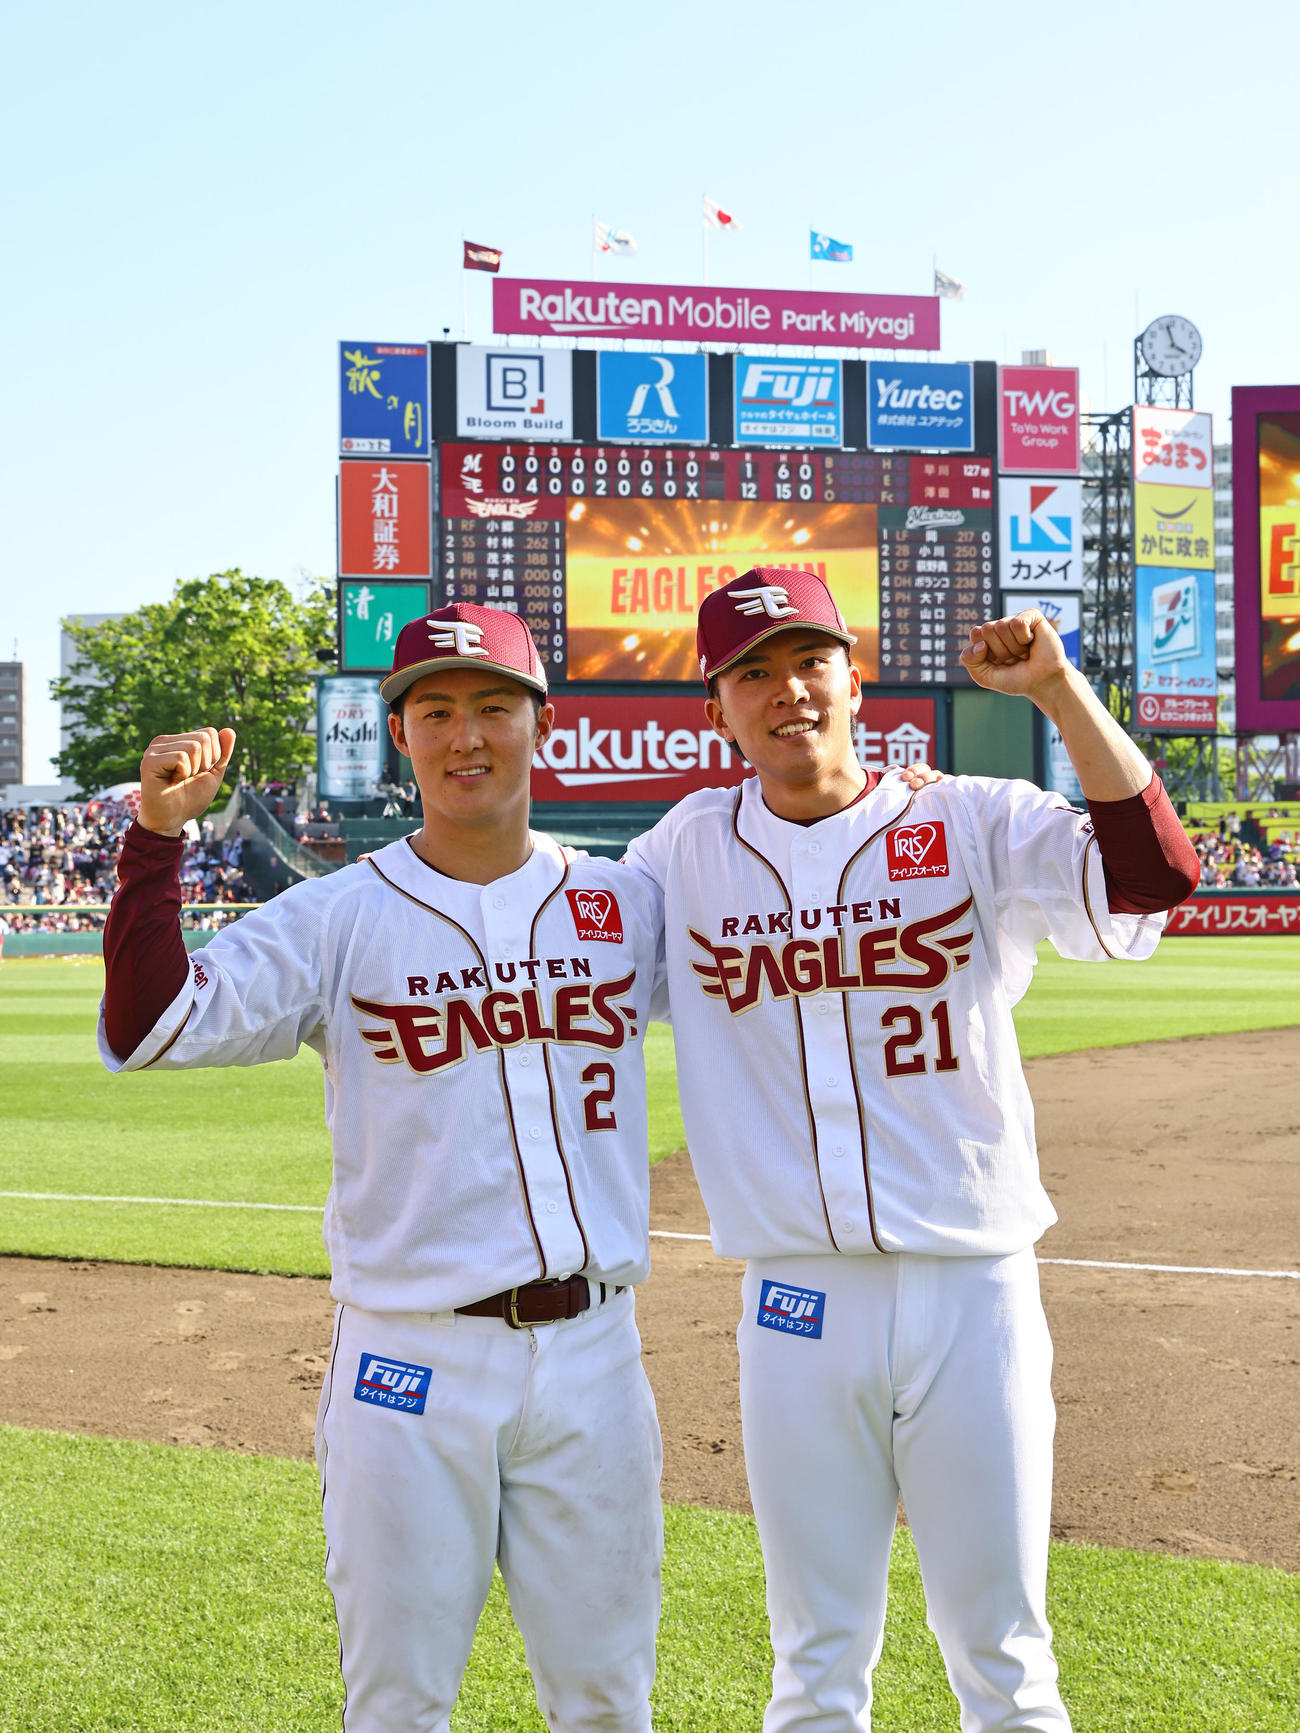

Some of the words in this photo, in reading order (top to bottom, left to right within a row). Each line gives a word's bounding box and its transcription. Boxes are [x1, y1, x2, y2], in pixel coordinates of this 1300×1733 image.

[520, 288, 662, 327] Rakuten
[668, 296, 771, 330] Mobile
[782, 310, 836, 332] Park
[840, 311, 914, 340] Miyagi
[741, 364, 835, 406] Fuji
[876, 379, 964, 411] Yurtec
[1003, 389, 1075, 419] TWG
[466, 417, 517, 428] Bloom
[523, 418, 563, 430] Build
[627, 418, 678, 434] ろうきん
[878, 414, 917, 426] 株式会社
[917, 416, 964, 428] ユアテック
[1011, 422, 1039, 435] ToYo
[1040, 423, 1069, 435] Work
[1021, 435, 1059, 448] Group
[529, 446, 535, 456] 2
[551, 447, 558, 456] 3
[574, 448, 581, 457] 4
[644, 449, 650, 458] 7
[689, 451, 696, 459] 9
[502, 456, 515, 473] 0
[525, 457, 538, 473] 0
[549, 457, 562, 474] 0
[572, 458, 584, 474] 0
[595, 459, 607, 475] 0
[618, 459, 630, 475] 0
[640, 460, 653, 476] 0
[666, 461, 673, 477] 1
[686, 461, 698, 477] 0
[745, 463, 752, 478] 1
[778, 464, 790, 480] 6
[800, 464, 812, 480] 0
[882, 458, 892, 470] H
[825, 473, 833, 485] S
[502, 477, 515, 493] 0
[526, 477, 538, 494] 4
[549, 478, 562, 494] 0
[572, 479, 584, 495] 0
[595, 479, 607, 495] 2
[618, 480, 630, 496] 0
[641, 480, 653, 496] 6
[664, 480, 676, 497] 0
[686, 481, 698, 498] X
[741, 482, 757, 499] 12
[776, 483, 792, 499] 15
[800, 484, 812, 500] 0
[371, 467, 400, 570] 大和証券
[447, 519, 453, 531] 1
[461, 520, 476, 532] RF
[555, 521, 560, 533] 1
[445, 535, 455, 548] 2
[462, 536, 476, 548] SS
[555, 537, 560, 550] 1
[883, 528, 888, 540] 1
[981, 531, 991, 543] 0
[881, 544, 890, 556] 2
[981, 546, 991, 558] 0
[1141, 534, 1209, 559] かに政宗
[446, 551, 455, 564] 3
[555, 554, 560, 566] 1
[881, 560, 890, 572] 3
[982, 561, 992, 573] 0
[1011, 560, 1072, 580] カメイ
[445, 568, 455, 580] 4
[460, 568, 477, 579] PH
[552, 569, 563, 582] 0
[881, 575, 890, 587] 4
[983, 577, 992, 590] 5
[446, 584, 455, 596] 5
[552, 585, 563, 598] 0
[881, 591, 891, 603] 5
[920, 592, 946, 604] 大下
[982, 592, 992, 605] 0
[552, 601, 563, 614] 0
[882, 607, 891, 619] 6
[920, 607, 946, 620] 山口
[983, 608, 992, 621] 2
[555, 618, 561, 630] 1
[882, 622, 891, 634] 7
[553, 634, 563, 647] 0
[882, 638, 891, 650] 8
[553, 650, 563, 663] 0
[882, 654, 891, 666] 9
[326, 721, 377, 743] Asahi
[890, 865, 947, 879] アイリスオーヤマ
[721, 898, 902, 938] RAKUTEN
[1178, 904, 1300, 929] アイリスオーヤ
[579, 930, 622, 941] アイリスオーヤマ
[687, 893, 974, 1017] EAGLES
[407, 958, 592, 996] RAKUTEN
[351, 969, 638, 1076] EAGLES
[880, 1000, 960, 1078] 21
[580, 1062, 618, 1133] 2
[765, 1285, 819, 1318] Fuji
[762, 1312, 814, 1332] タイヤはフジ
[363, 1359, 425, 1393] Fuji
[360, 1386, 417, 1408] タイヤはフジ
